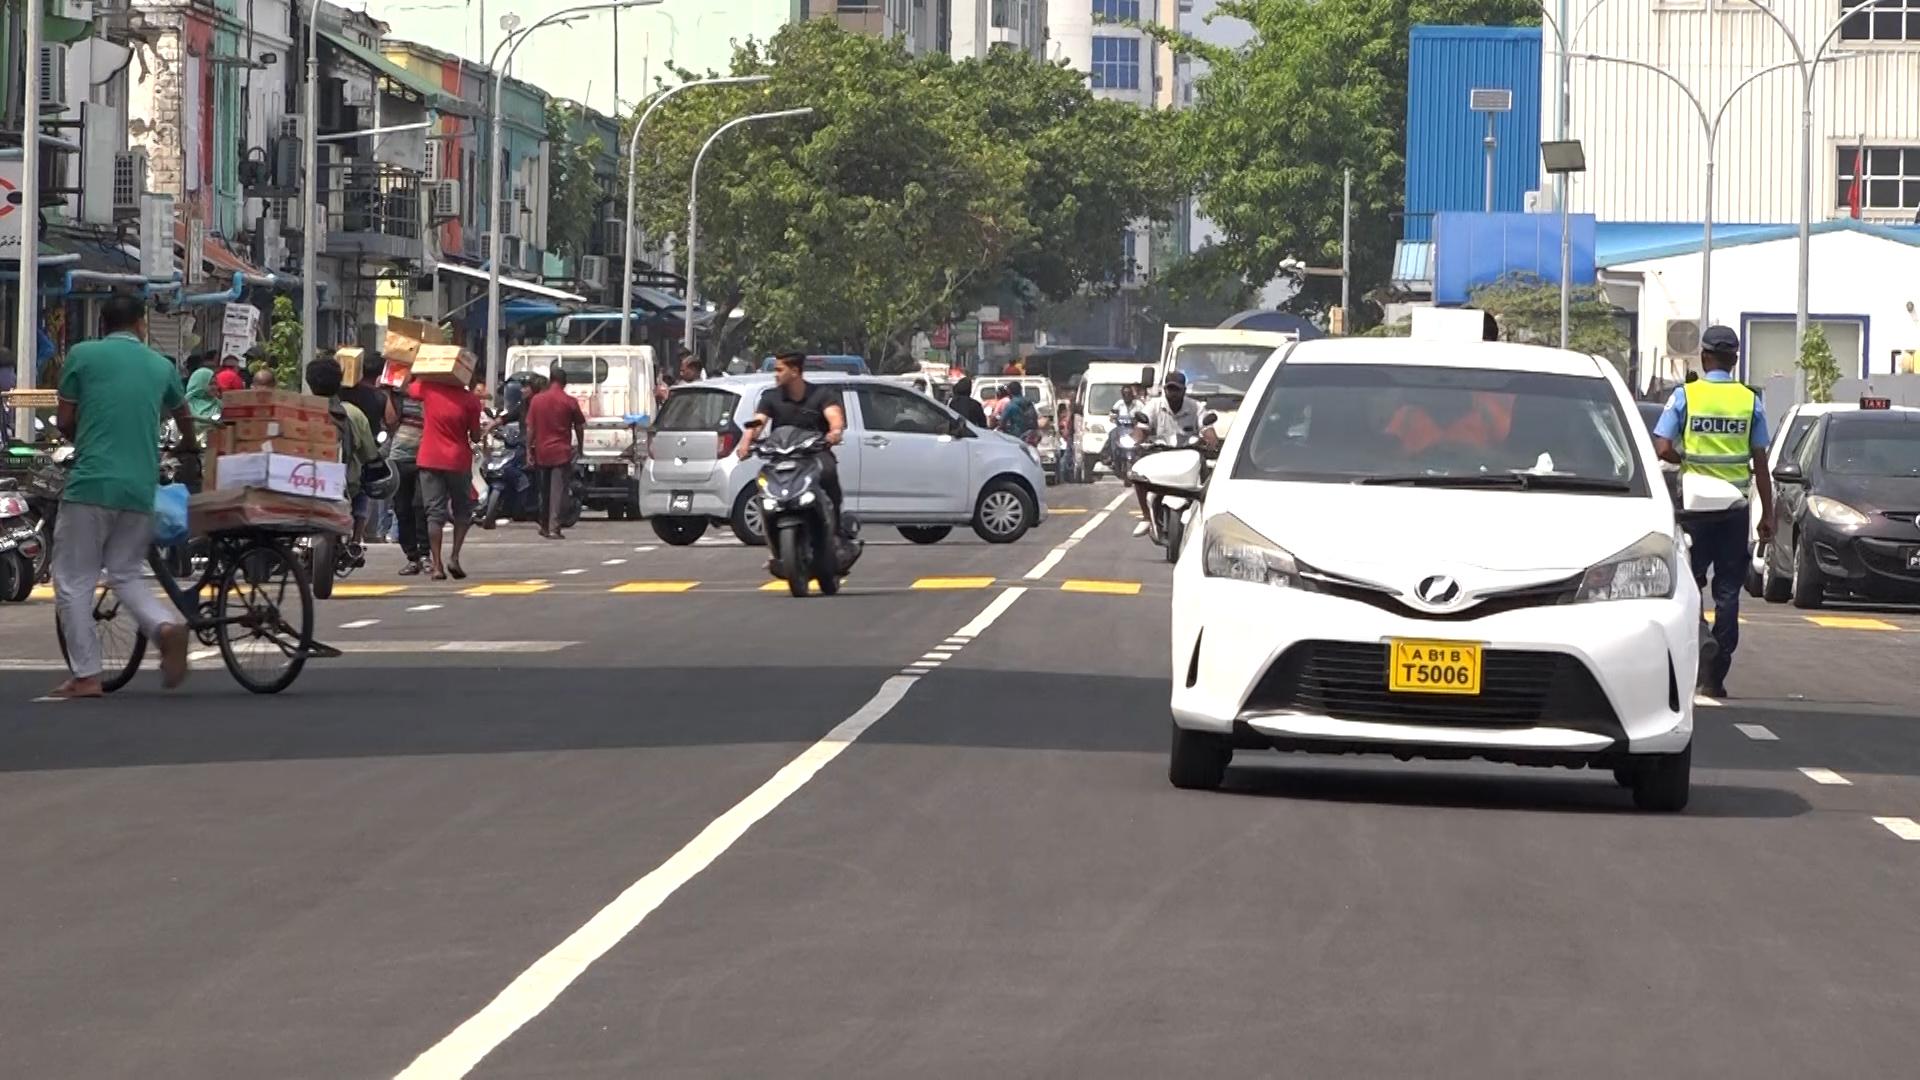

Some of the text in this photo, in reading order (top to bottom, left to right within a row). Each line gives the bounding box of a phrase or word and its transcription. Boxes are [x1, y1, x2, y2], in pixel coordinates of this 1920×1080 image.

[1864, 399, 1886, 409] TAXI
[1691, 418, 1746, 433] POLICE
[1412, 649, 1423, 660] A
[1451, 651, 1462, 662] B
[1402, 663, 1469, 684] T5006
